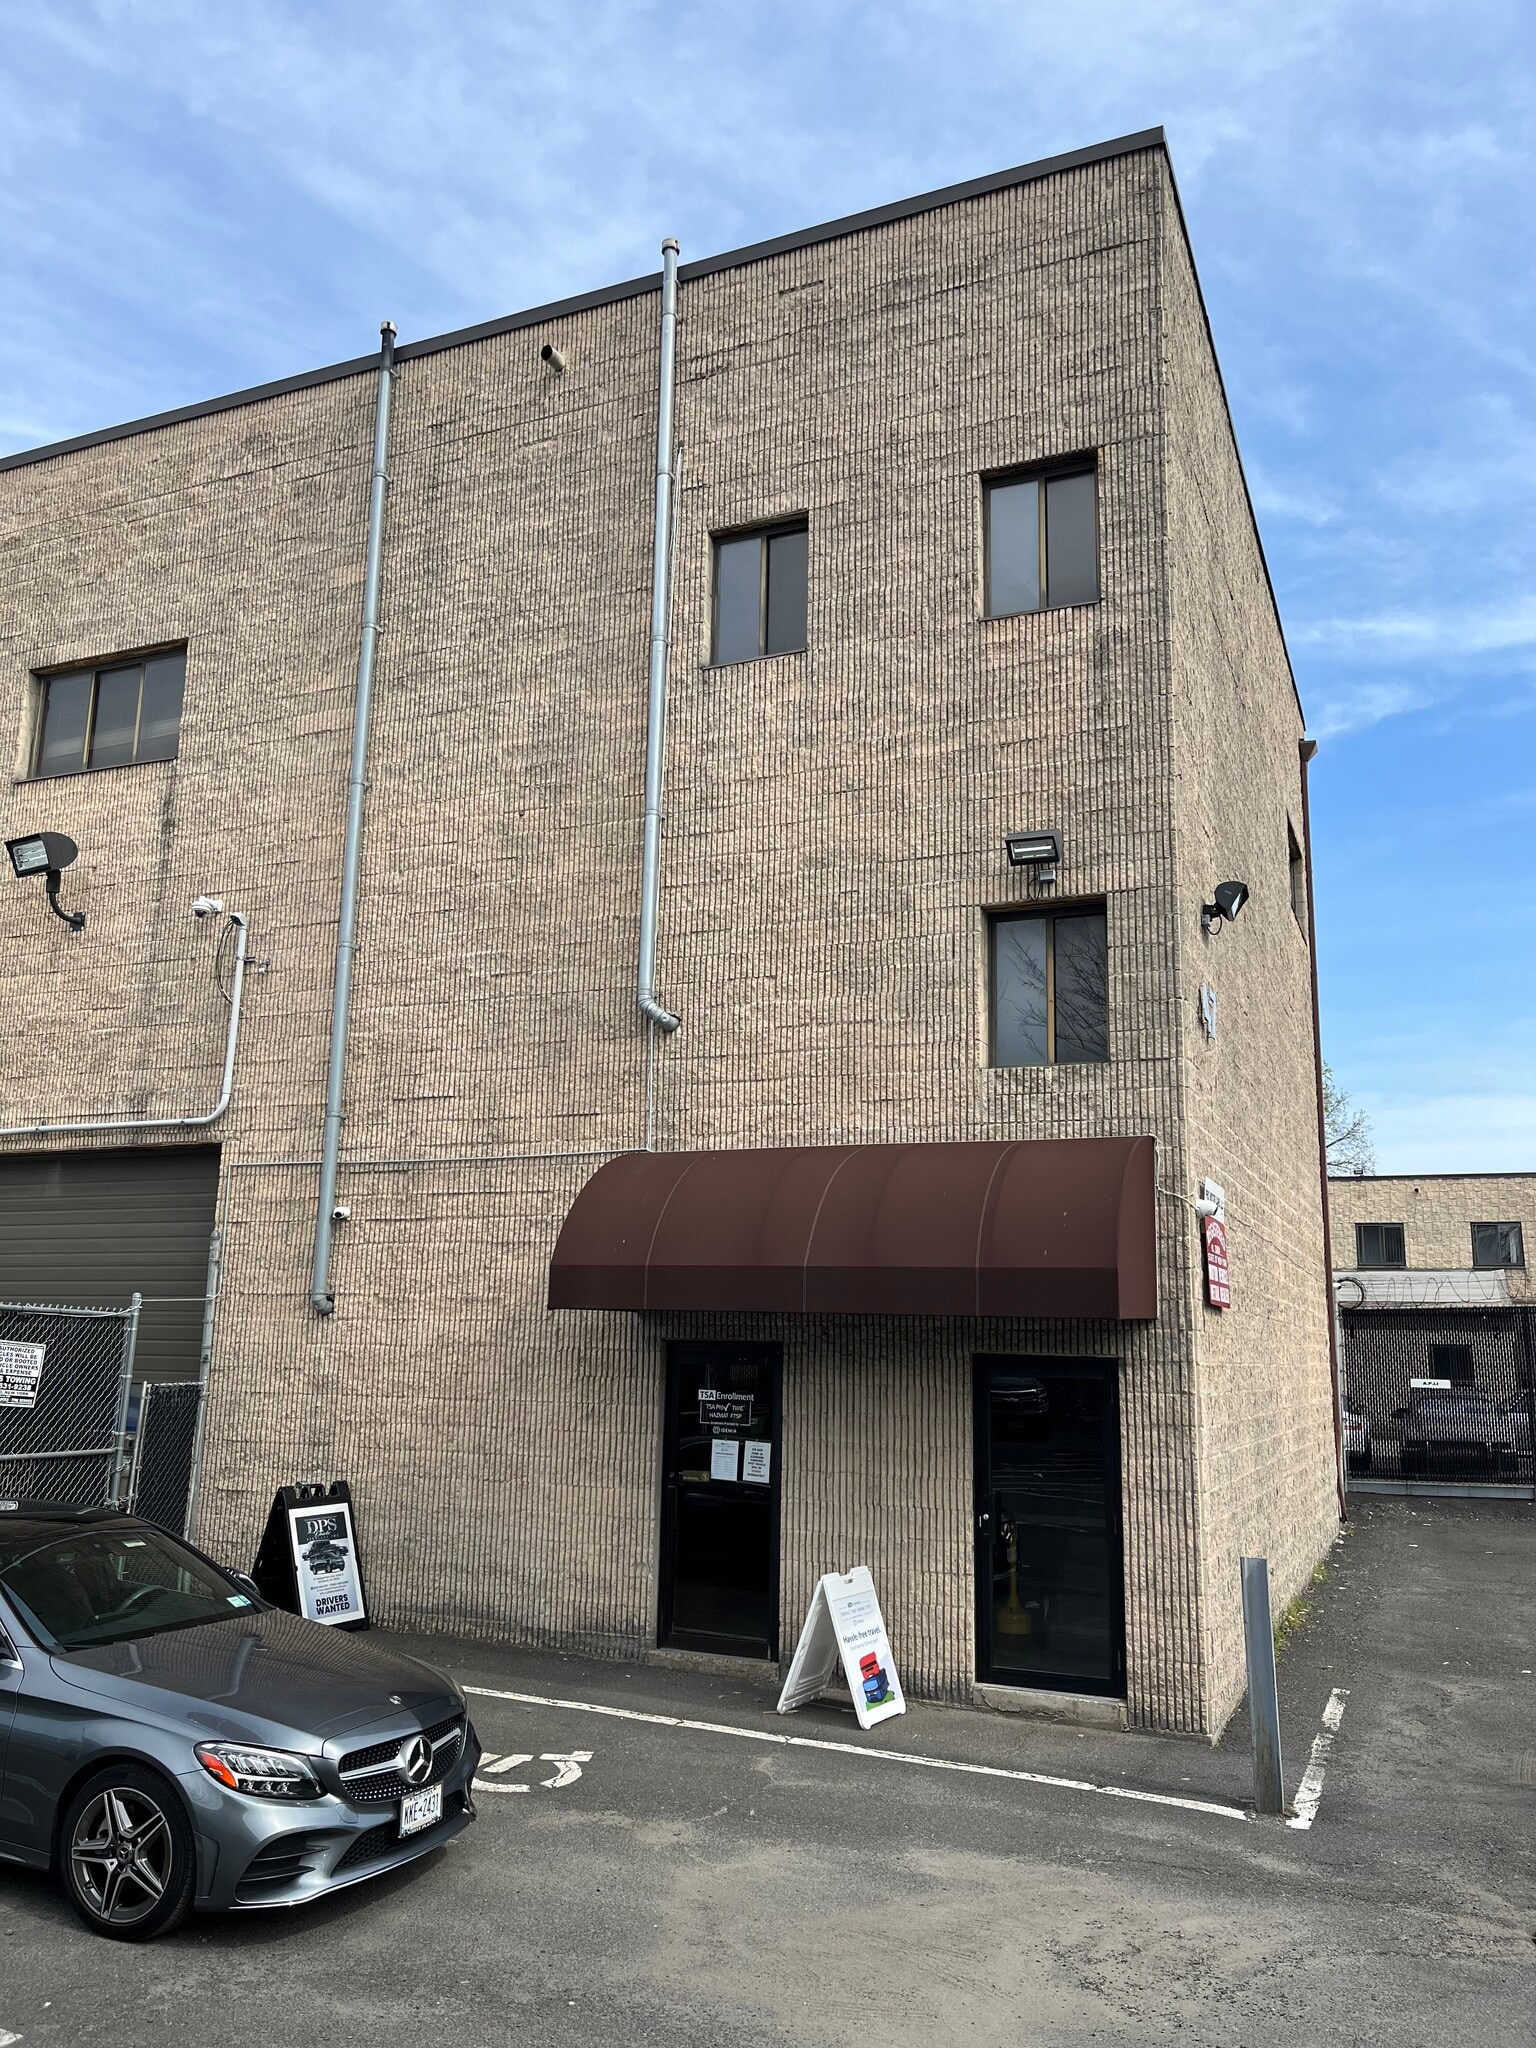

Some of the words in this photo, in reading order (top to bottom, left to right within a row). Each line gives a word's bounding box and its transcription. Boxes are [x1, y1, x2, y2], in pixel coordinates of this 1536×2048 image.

[5, 1376, 37, 1385] TOWING
[699, 1390, 715, 1399] TSA
[716, 1391, 754, 1401] Enrollment
[306, 1518, 338, 1535] DPS
[316, 1594, 348, 1607] DRIVERS
[316, 1602, 350, 1616] WANTED
